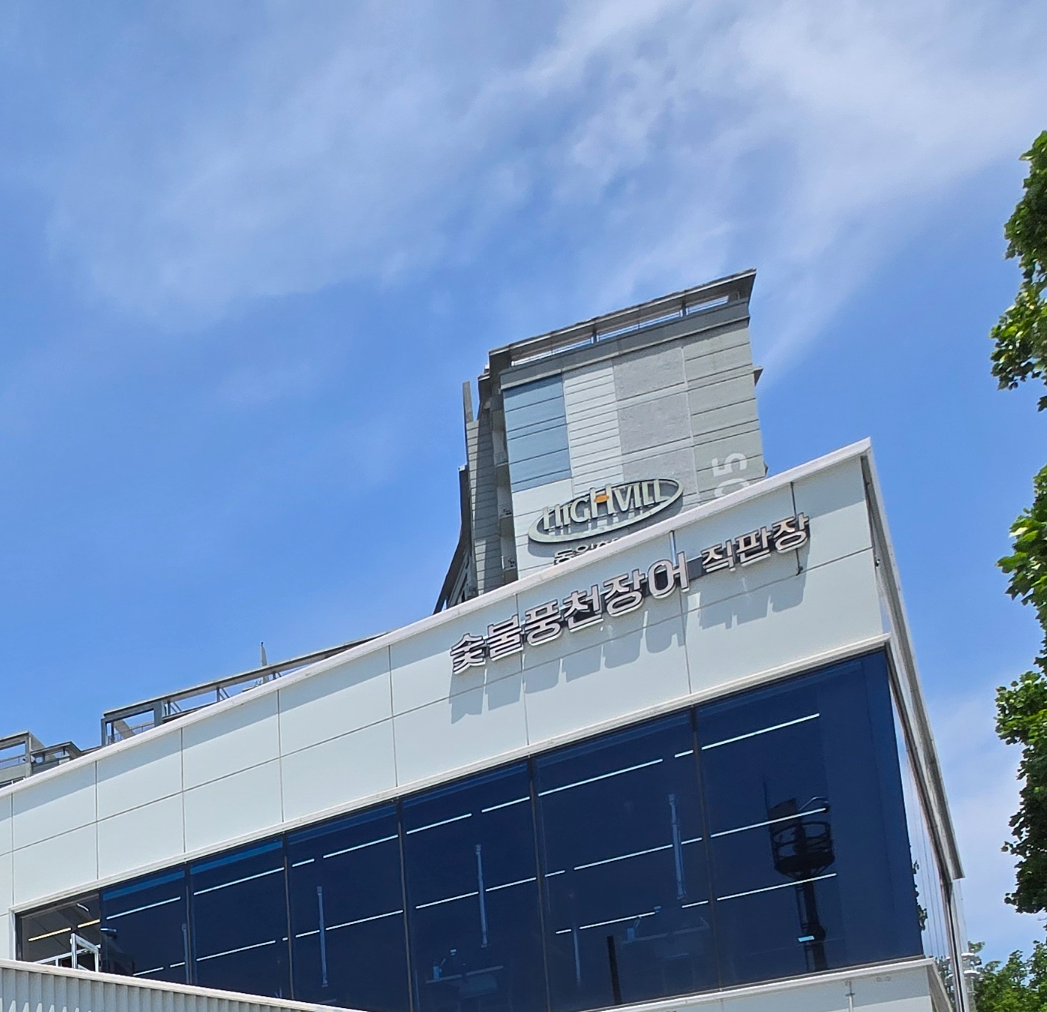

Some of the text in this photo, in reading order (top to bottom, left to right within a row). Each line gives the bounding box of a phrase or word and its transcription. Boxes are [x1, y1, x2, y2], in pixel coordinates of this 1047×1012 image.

[542, 479, 663, 531] HIGHVILL
[450, 512, 811, 674] 숯불풍천장어 직판장
